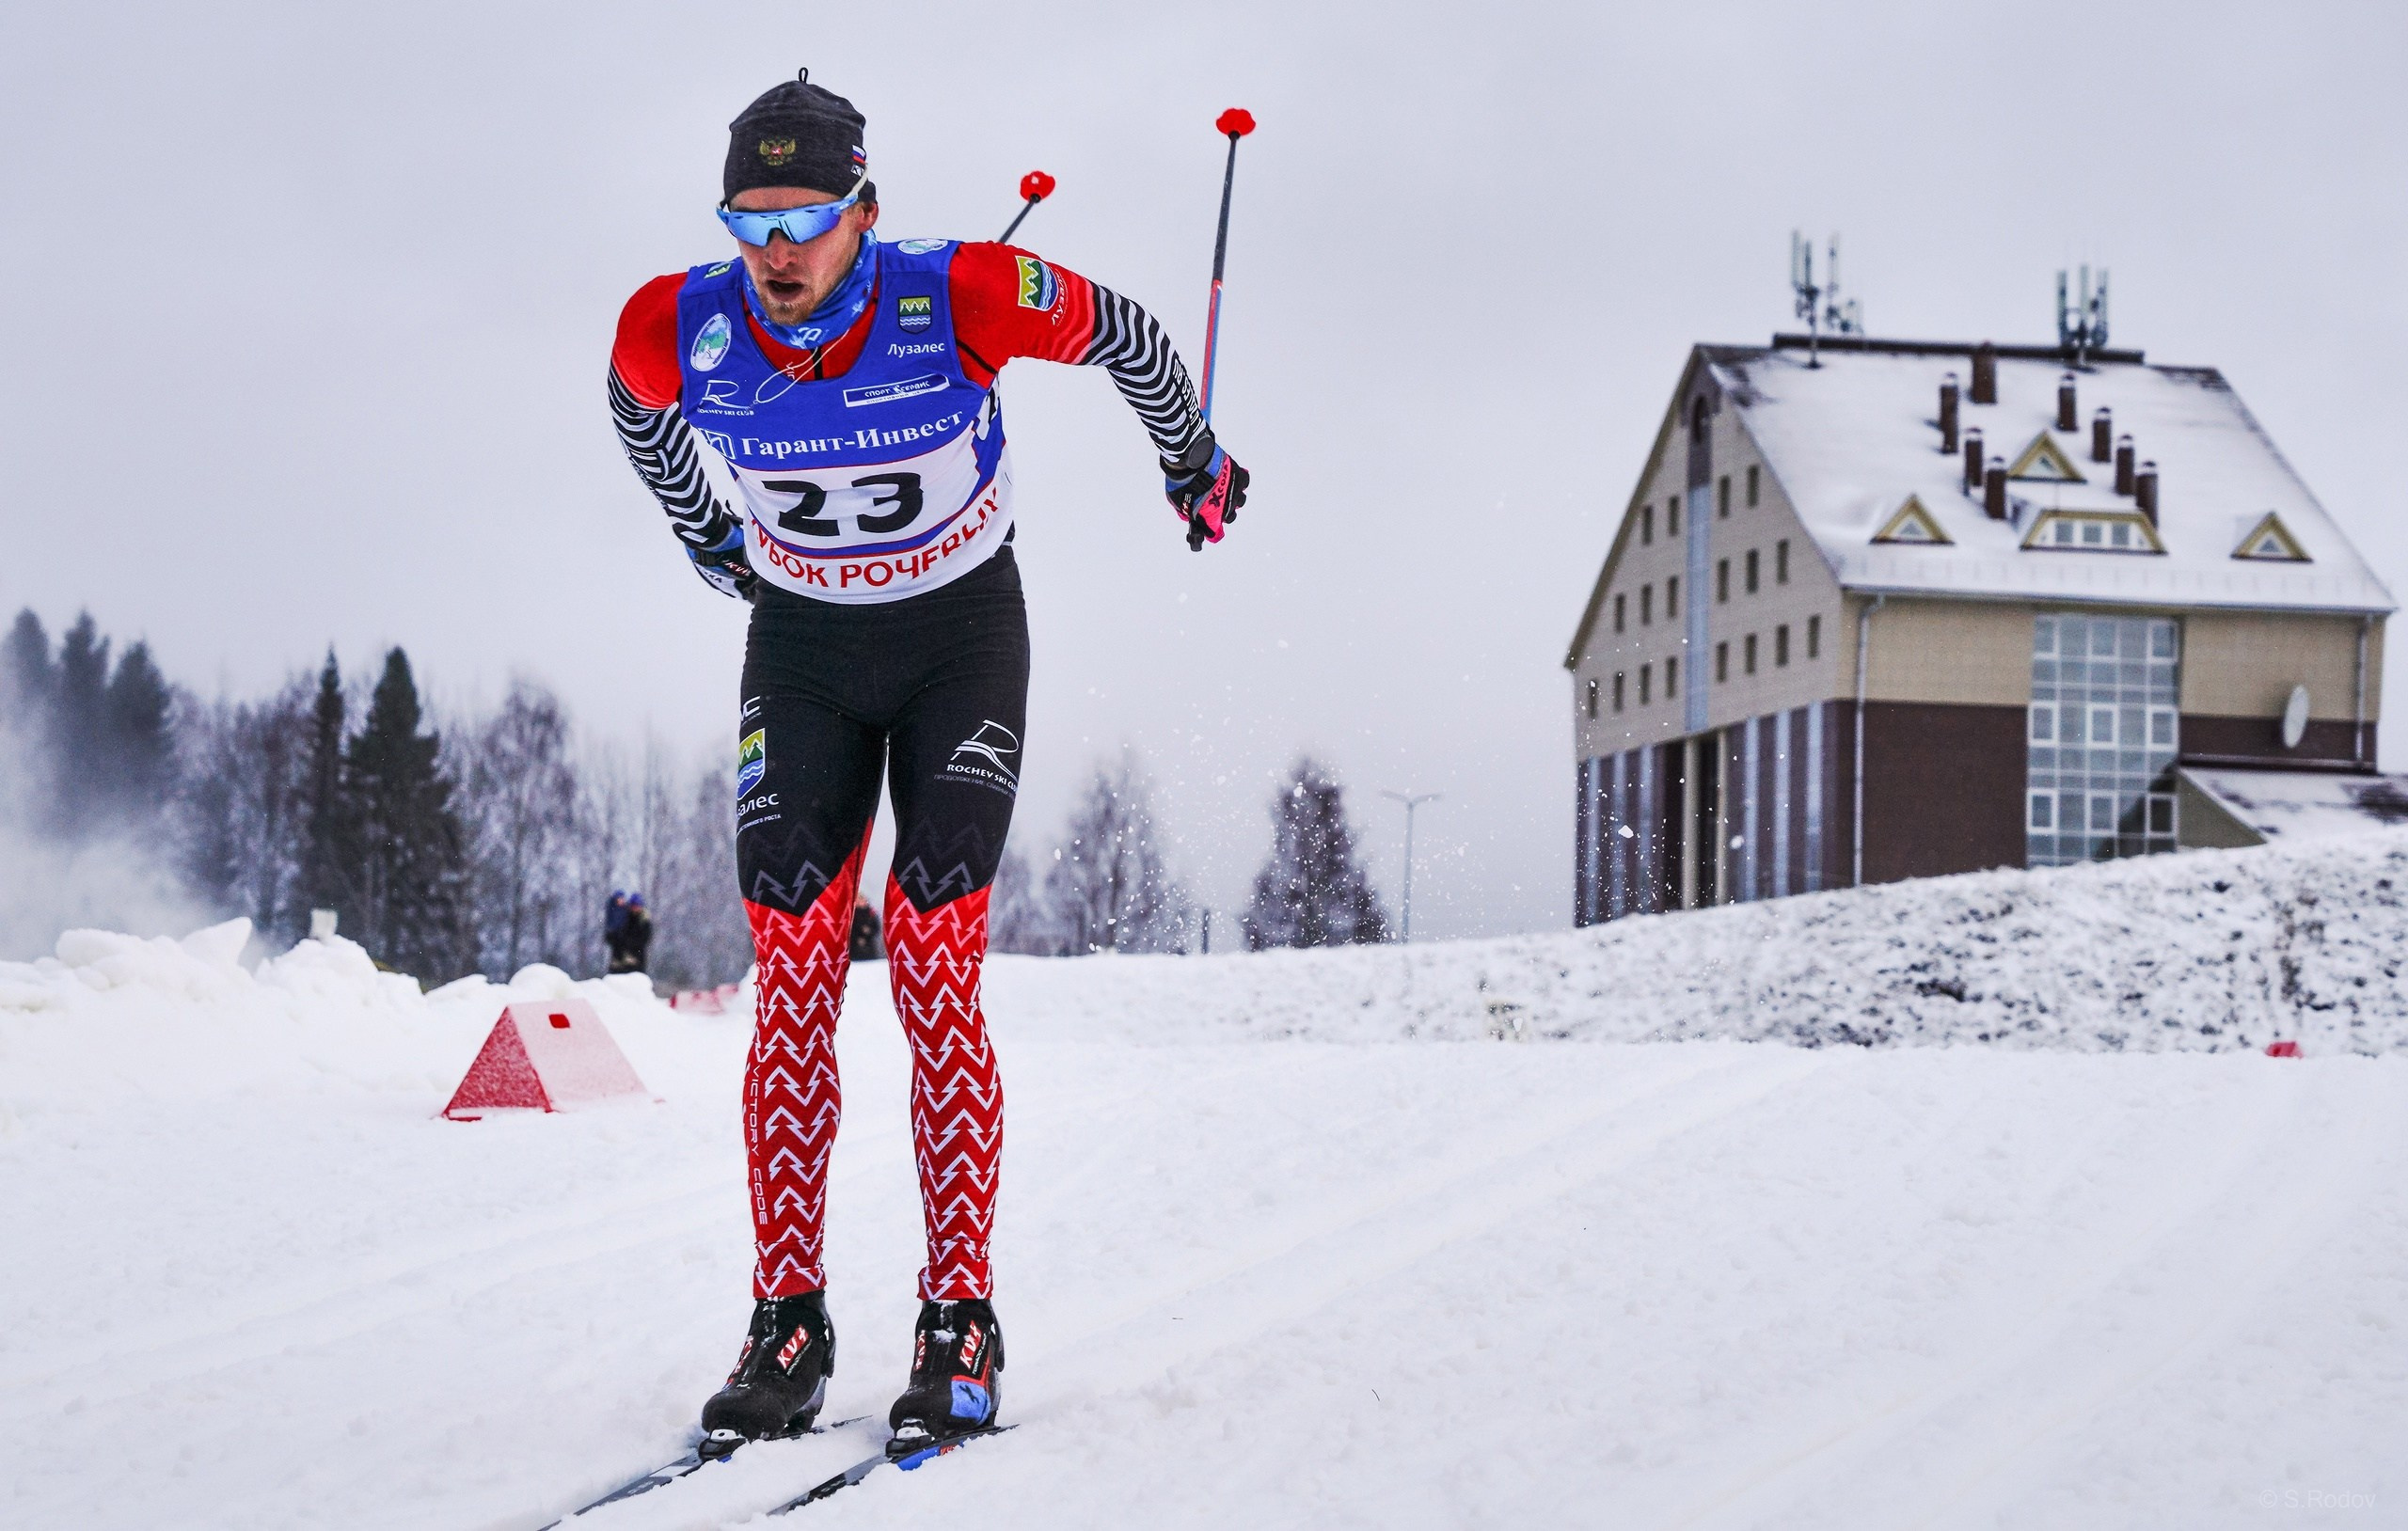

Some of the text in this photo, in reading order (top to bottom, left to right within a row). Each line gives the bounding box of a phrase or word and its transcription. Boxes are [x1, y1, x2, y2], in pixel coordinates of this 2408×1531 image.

[887, 342, 945, 357] Лузалес
[740, 411, 962, 459] Гарант-Инвест
[761, 473, 924, 536] 23
[946, 764, 993, 778] ROCHEV
[994, 774, 1006, 785] SKI
[750, 1065, 768, 1225] VICTORY CODE
